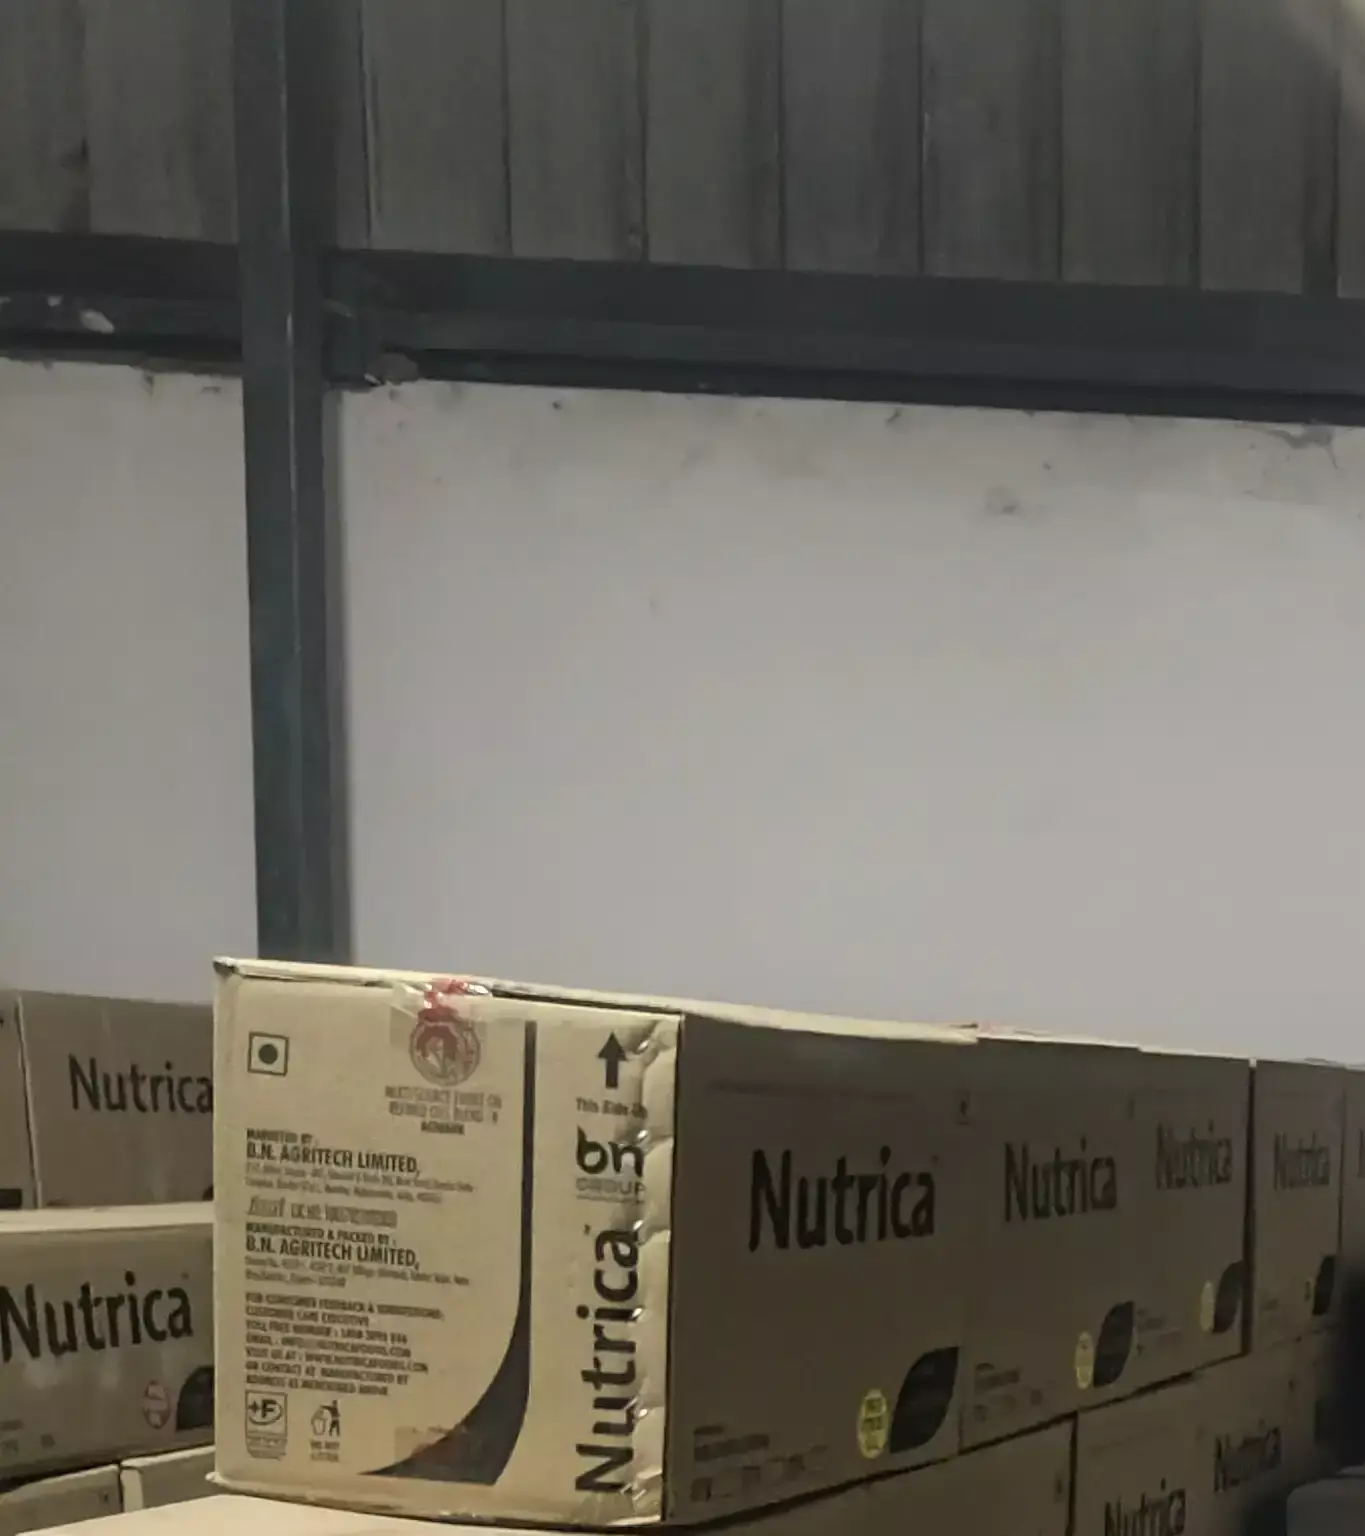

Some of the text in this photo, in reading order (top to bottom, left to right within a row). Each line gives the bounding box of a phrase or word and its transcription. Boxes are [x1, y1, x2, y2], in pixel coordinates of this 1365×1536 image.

[68, 1054, 213, 1113] Nutrica
[279, 1146, 353, 1169] AGRITECH
[357, 1152, 421, 1176] LIMITED,
[1004, 1137, 1118, 1222] Nutrica
[1156, 1121, 1233, 1190] Nutrica
[748, 1145, 936, 1253] Nutrica
[279, 1239, 352, 1261] AGRITECH
[0, 1270, 193, 1363] Nutrica
[575, 1227, 641, 1495] Nutrica
